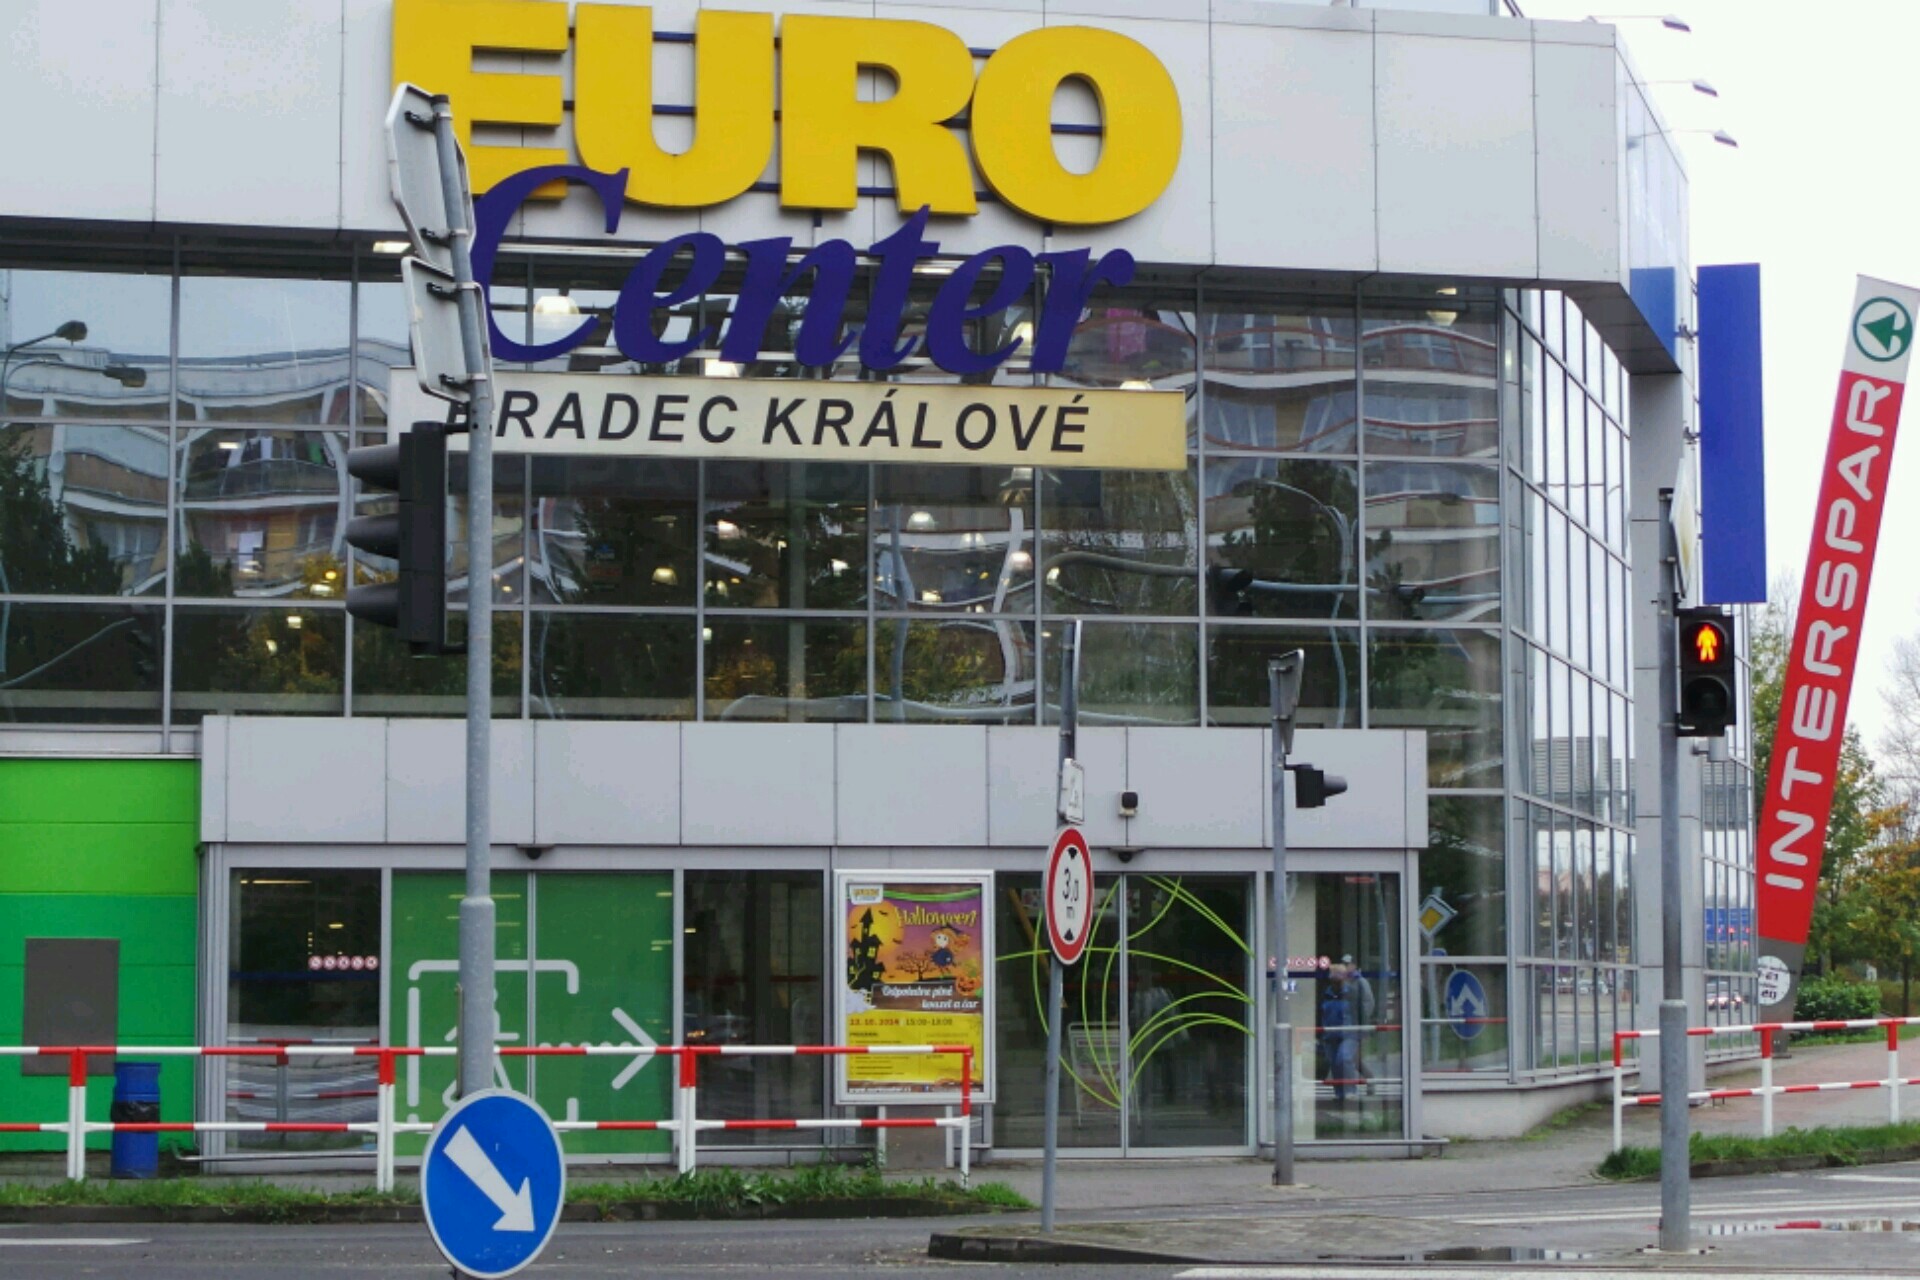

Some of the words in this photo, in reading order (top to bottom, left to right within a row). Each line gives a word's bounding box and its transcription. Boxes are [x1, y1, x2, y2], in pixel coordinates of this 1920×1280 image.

[393, 0, 1183, 225] EURO
[471, 165, 1136, 375] Center
[762, 388, 1090, 453] KRÁLOVÉ
[1765, 379, 1892, 890] INTERSPAR
